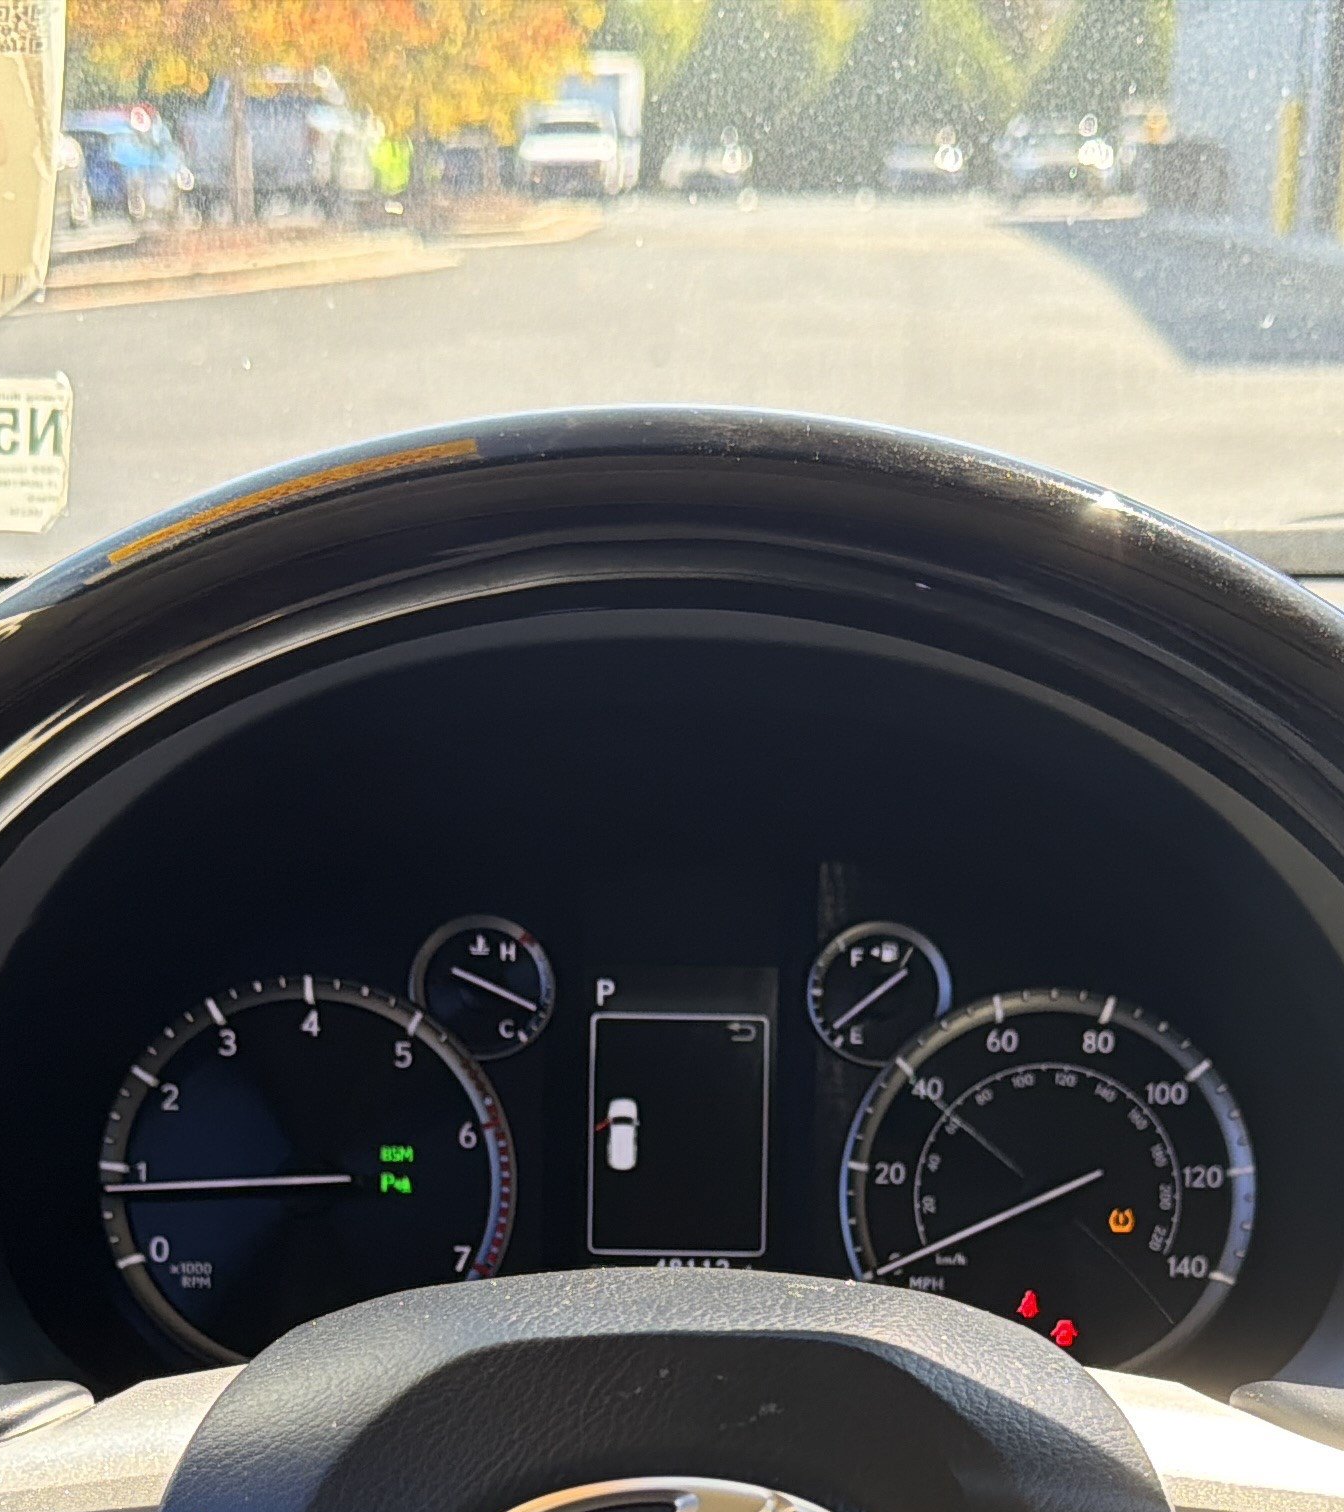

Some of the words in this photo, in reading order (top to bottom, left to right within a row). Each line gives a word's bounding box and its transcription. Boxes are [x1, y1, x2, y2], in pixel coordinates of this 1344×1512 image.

[500, 943, 516, 962] H
[850, 949, 863, 967] F
[596, 978, 615, 1006] P
[300, 1012, 320, 1037] 4
[499, 1020, 515, 1038] C
[850, 1027, 863, 1044] E
[218, 1029, 237, 1056] 3
[986, 1030, 1019, 1053] 60
[1083, 1030, 1114, 1053] 80
[394, 1041, 413, 1068] 5
[160, 1084, 179, 1111] 2
[912, 1077, 944, 1100] 40
[1146, 1082, 1189, 1105] 100
[458, 1121, 477, 1149] 6
[380, 1145, 414, 1162] BSM
[136, 1162, 147, 1182] 1
[874, 1162, 906, 1185] 20
[1182, 1166, 1223, 1189] 120
[149, 1236, 169, 1262] 0
[453, 1246, 471, 1272] 7
[1167, 1256, 1208, 1278] 140
[909, 1275, 946, 1291] MPH
